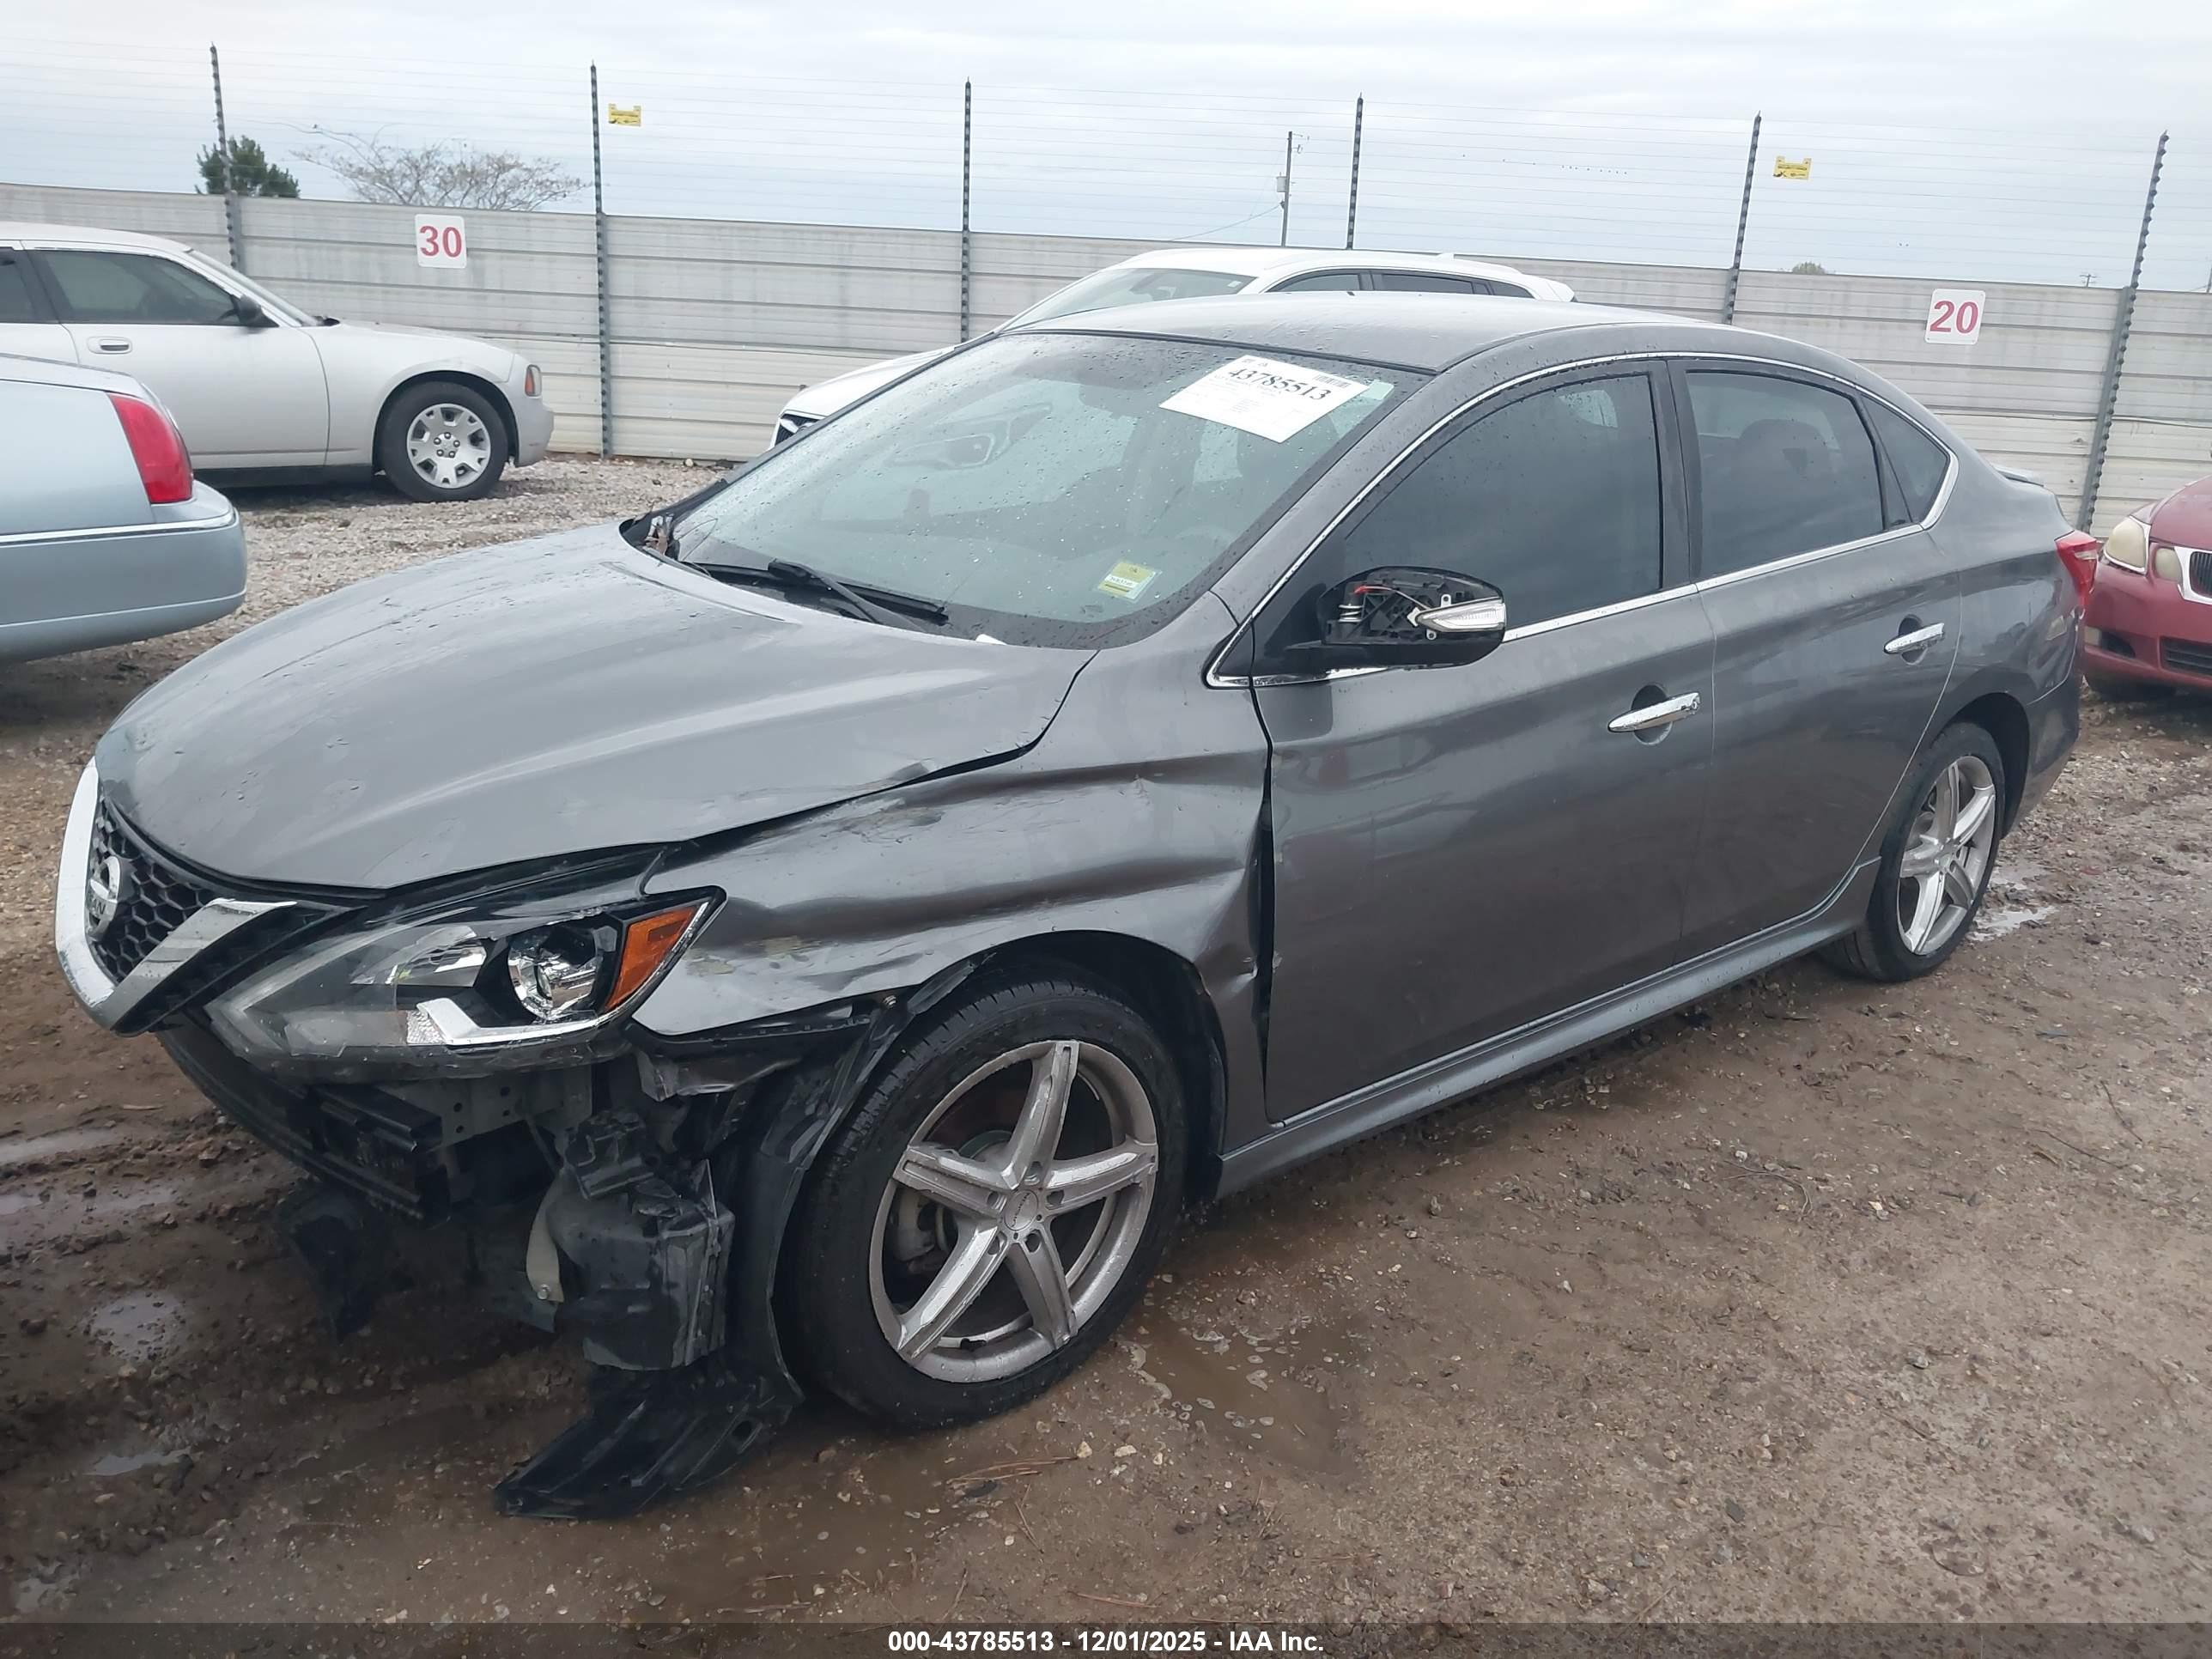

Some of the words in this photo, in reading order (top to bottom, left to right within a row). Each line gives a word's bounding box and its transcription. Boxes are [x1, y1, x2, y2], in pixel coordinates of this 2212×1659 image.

[419, 225, 462, 258] 30
[1929, 301, 1978, 334] 20
[1228, 368, 1332, 400] 43785513
